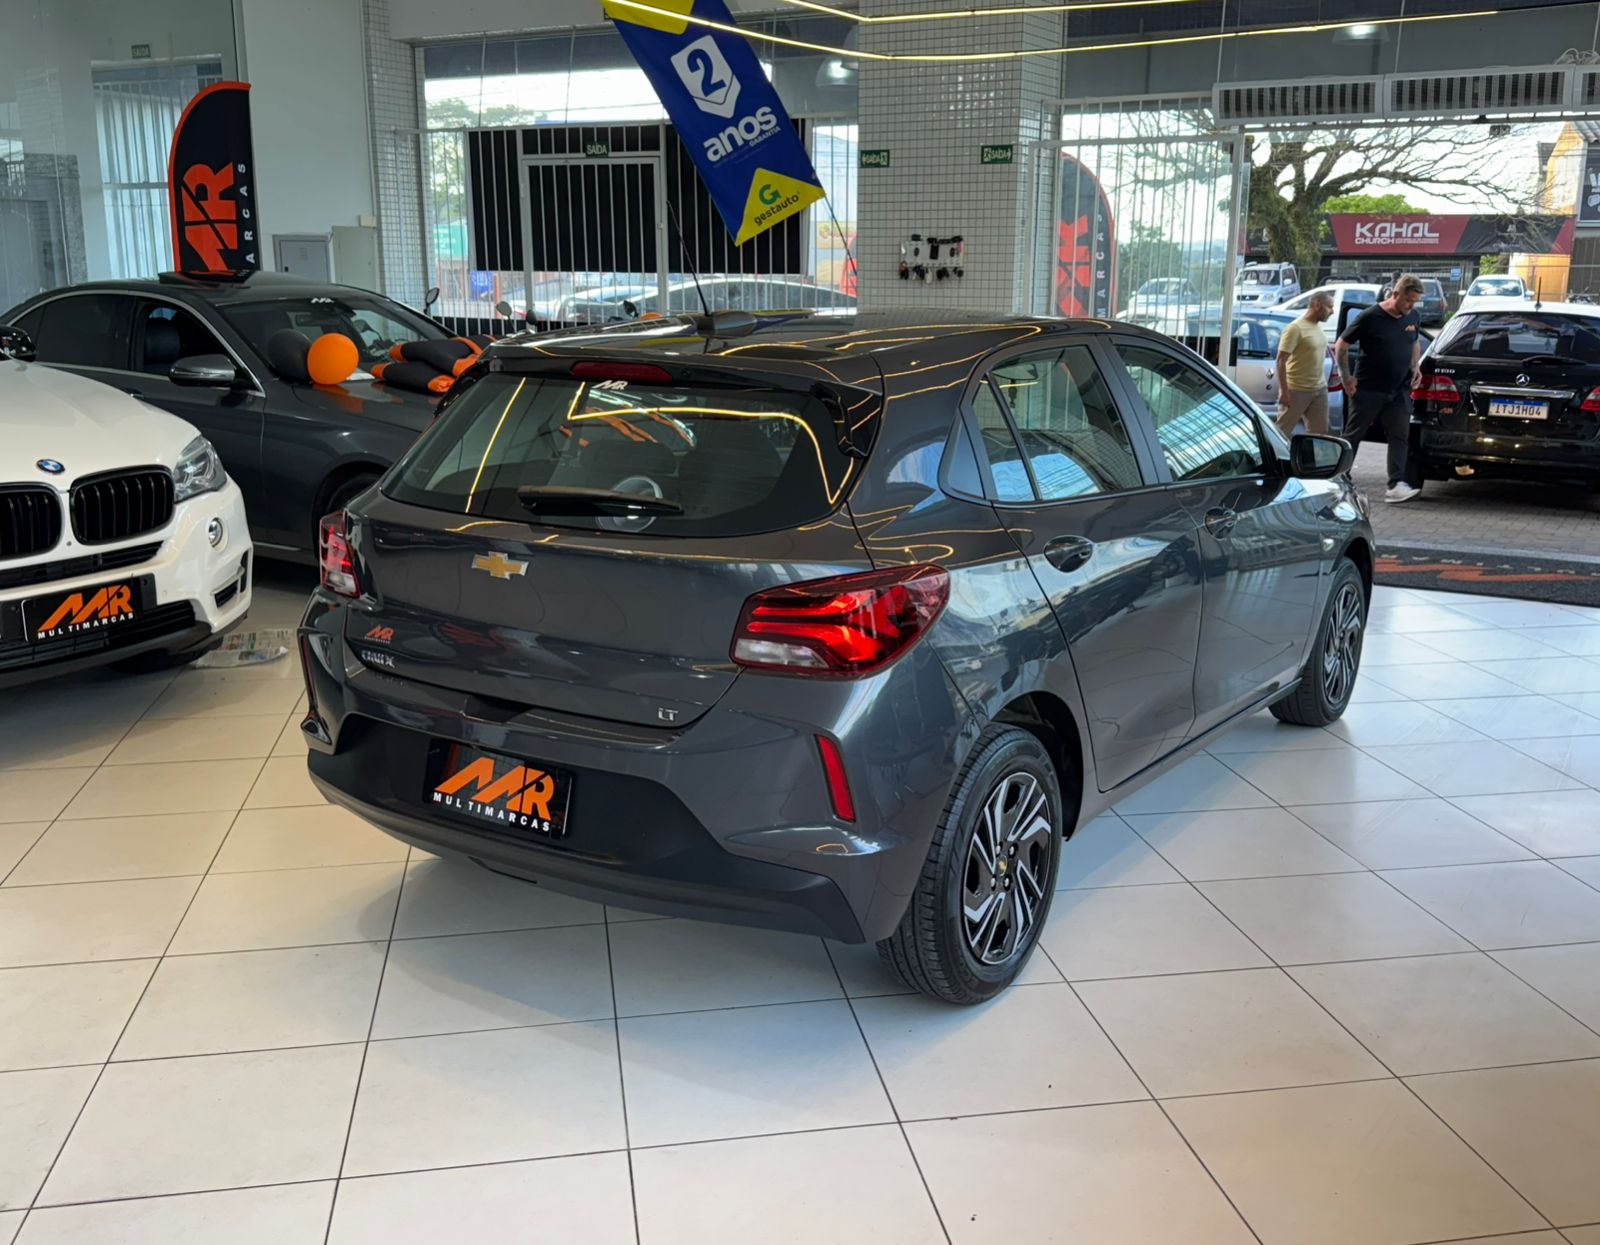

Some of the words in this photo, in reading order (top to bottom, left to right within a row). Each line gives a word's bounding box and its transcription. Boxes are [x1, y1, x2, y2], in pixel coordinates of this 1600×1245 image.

[687, 48, 727, 97] 2
[703, 106, 777, 162] anos
[753, 194, 800, 226] gestauto
[1355, 222, 1440, 237] KAHAL
[1355, 237, 1394, 245] CHURCH
[1495, 404, 1542, 416] ITJ1H04
[37, 585, 134, 632] MR
[37, 612, 134, 639] MULTIMARCAS
[658, 707, 679, 721] LT
[434, 757, 552, 821] MR
[433, 792, 550, 832] MULTIMARCAS
